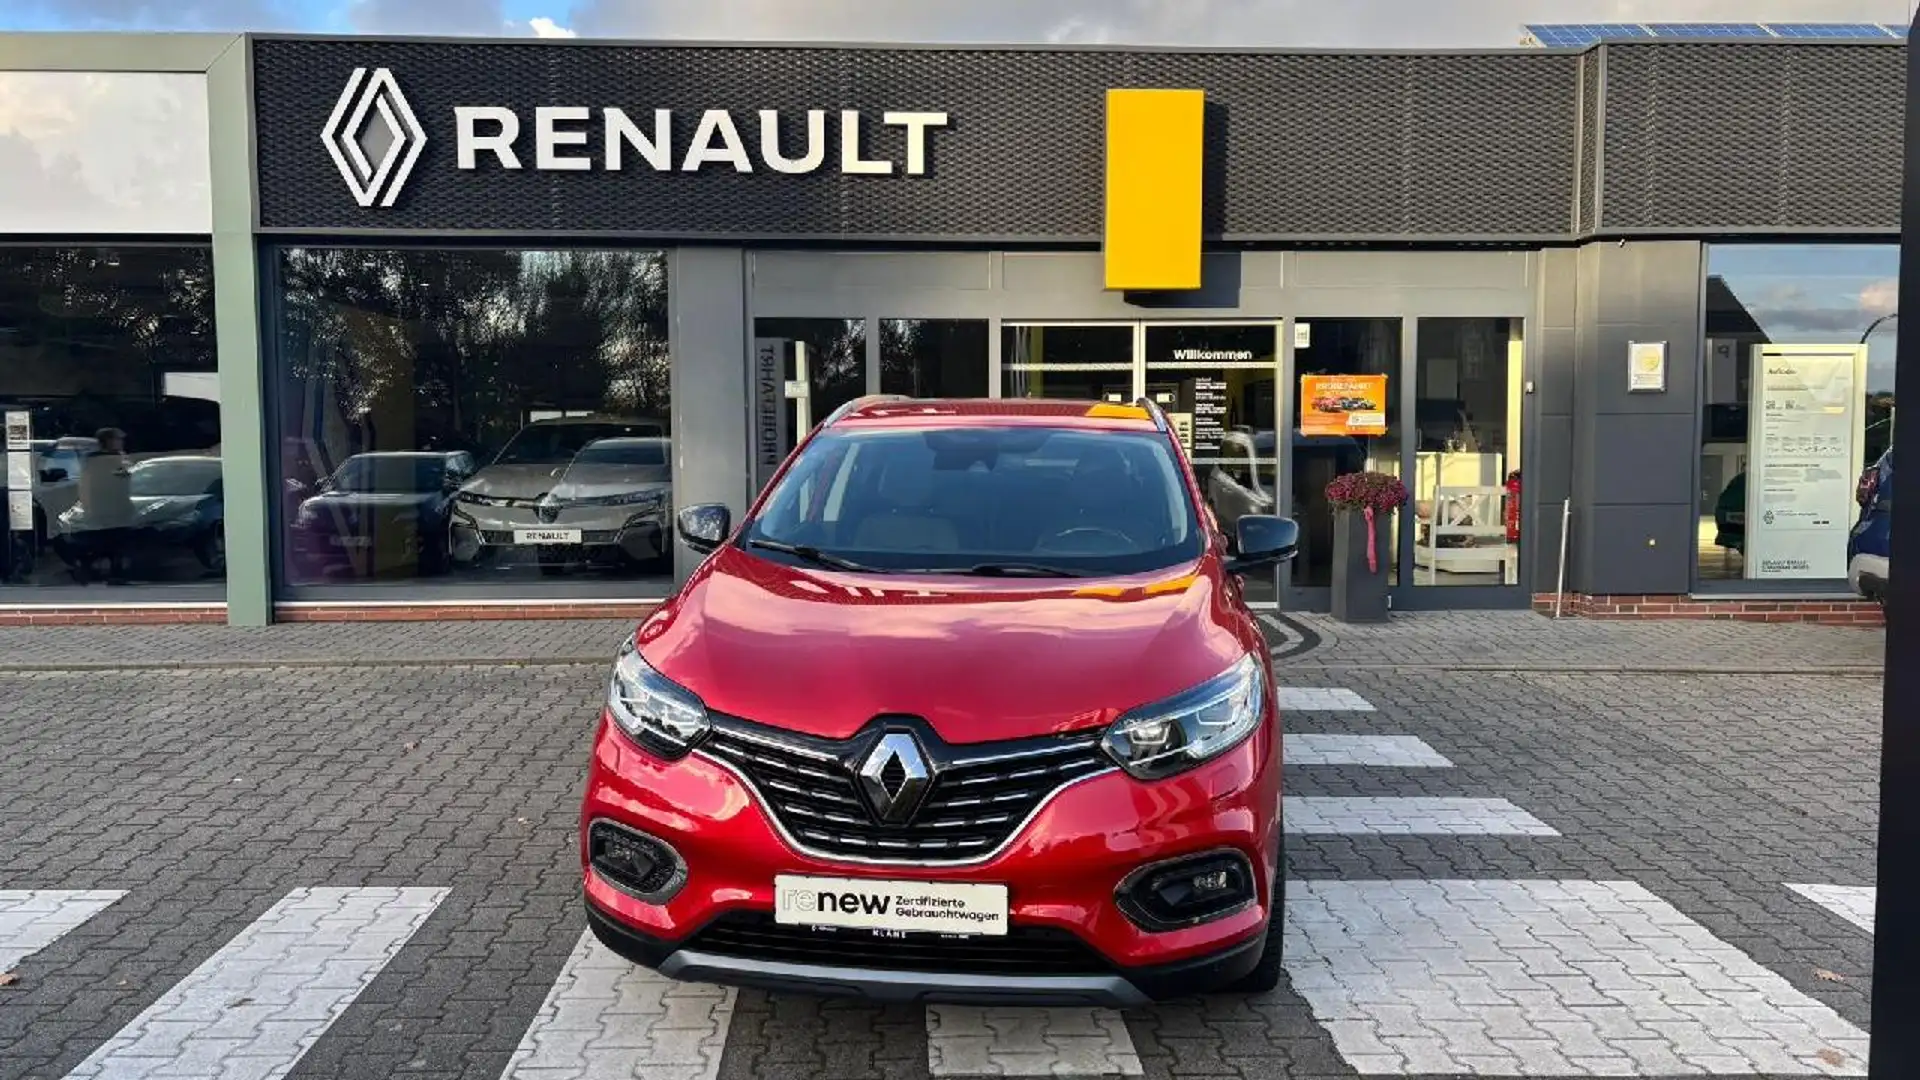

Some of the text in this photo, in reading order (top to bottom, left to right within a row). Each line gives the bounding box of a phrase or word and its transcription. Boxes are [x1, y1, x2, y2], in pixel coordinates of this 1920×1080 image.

[454, 106, 948, 174] RENAULT
[1173, 349, 1252, 360] Willkommen
[526, 532, 570, 540] RENAULT
[782, 888, 891, 915] renew
[895, 895, 966, 908] Zertifizierte
[895, 906, 999, 921] Gebrauchtwagen
